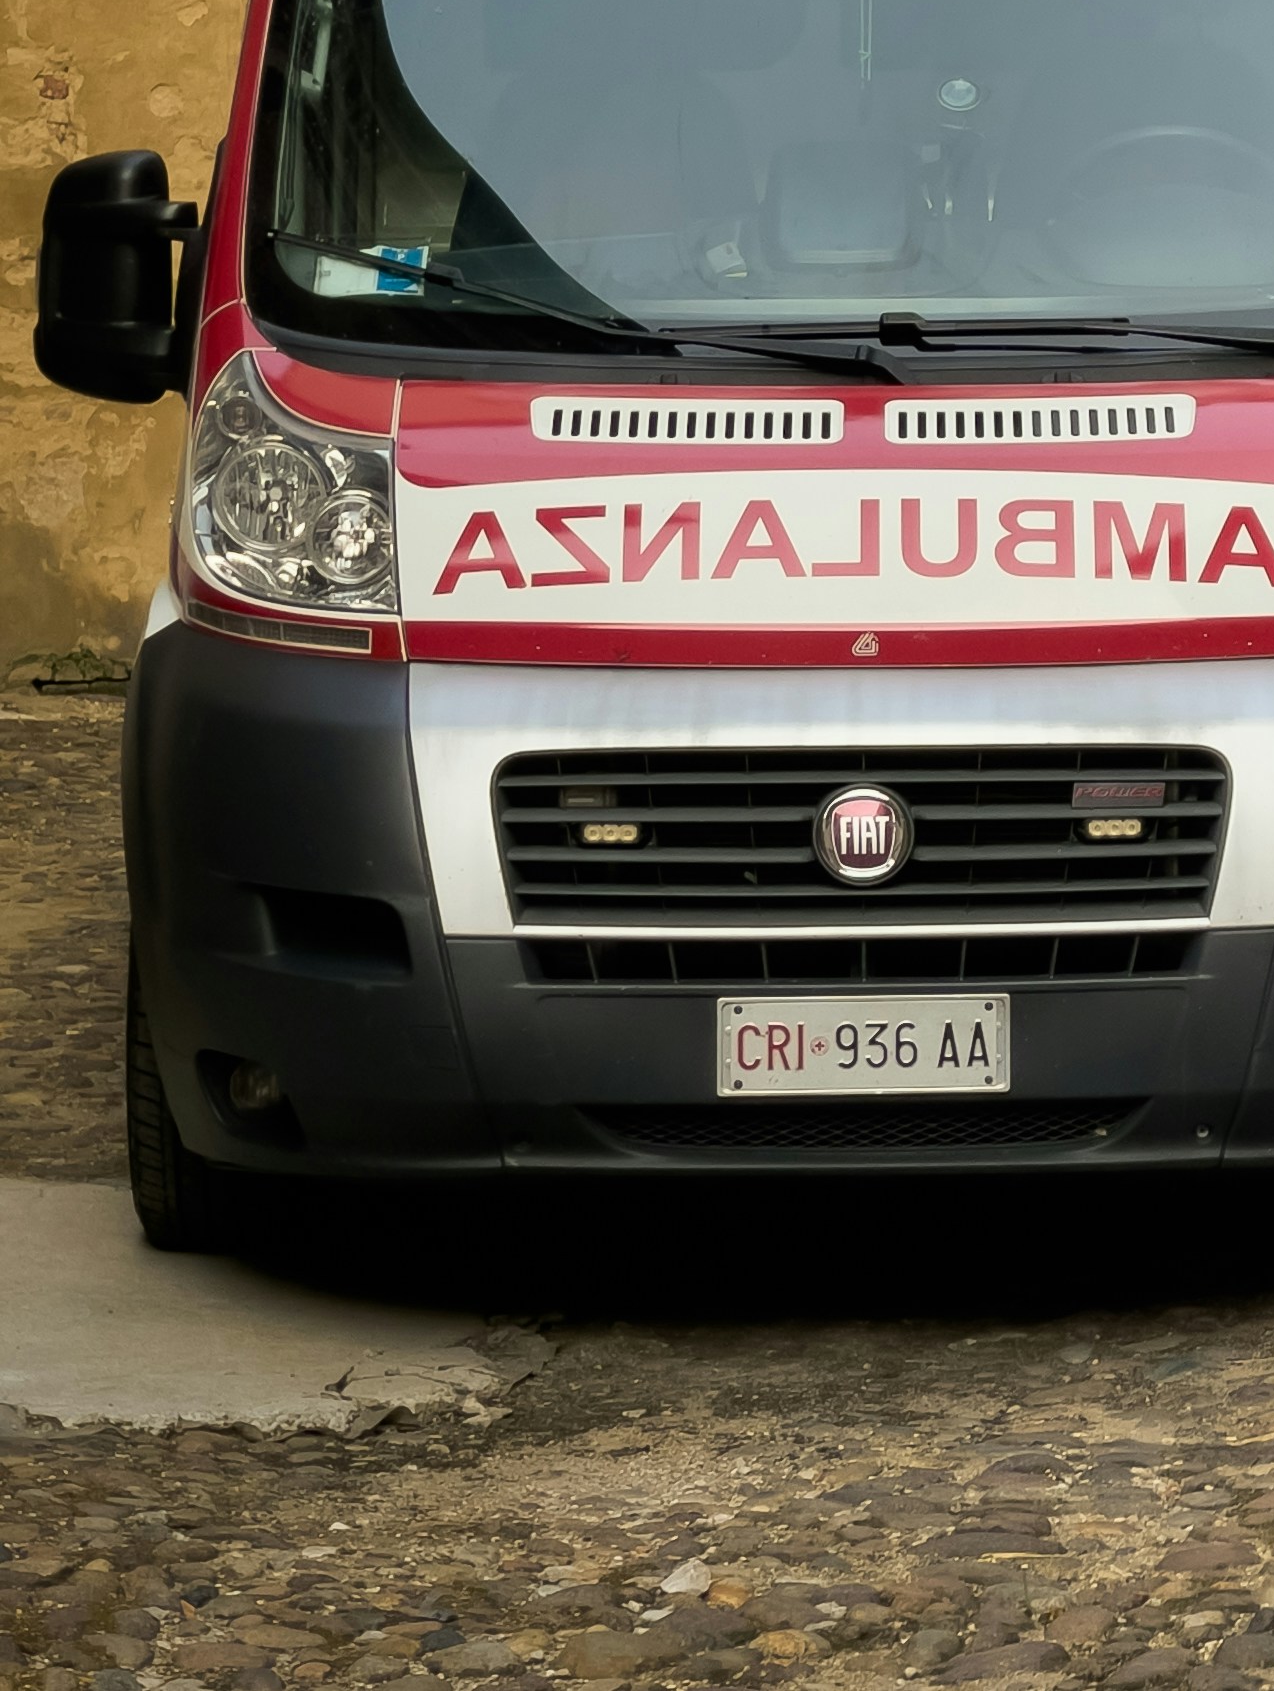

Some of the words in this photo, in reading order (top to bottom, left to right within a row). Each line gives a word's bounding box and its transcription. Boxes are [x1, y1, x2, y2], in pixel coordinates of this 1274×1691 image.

[1075, 787, 1163, 798] POWER
[840, 816, 889, 855] FIAT
[737, 1021, 805, 1071] CRI
[835, 1020, 918, 1069] 936
[937, 1019, 990, 1068] AA
